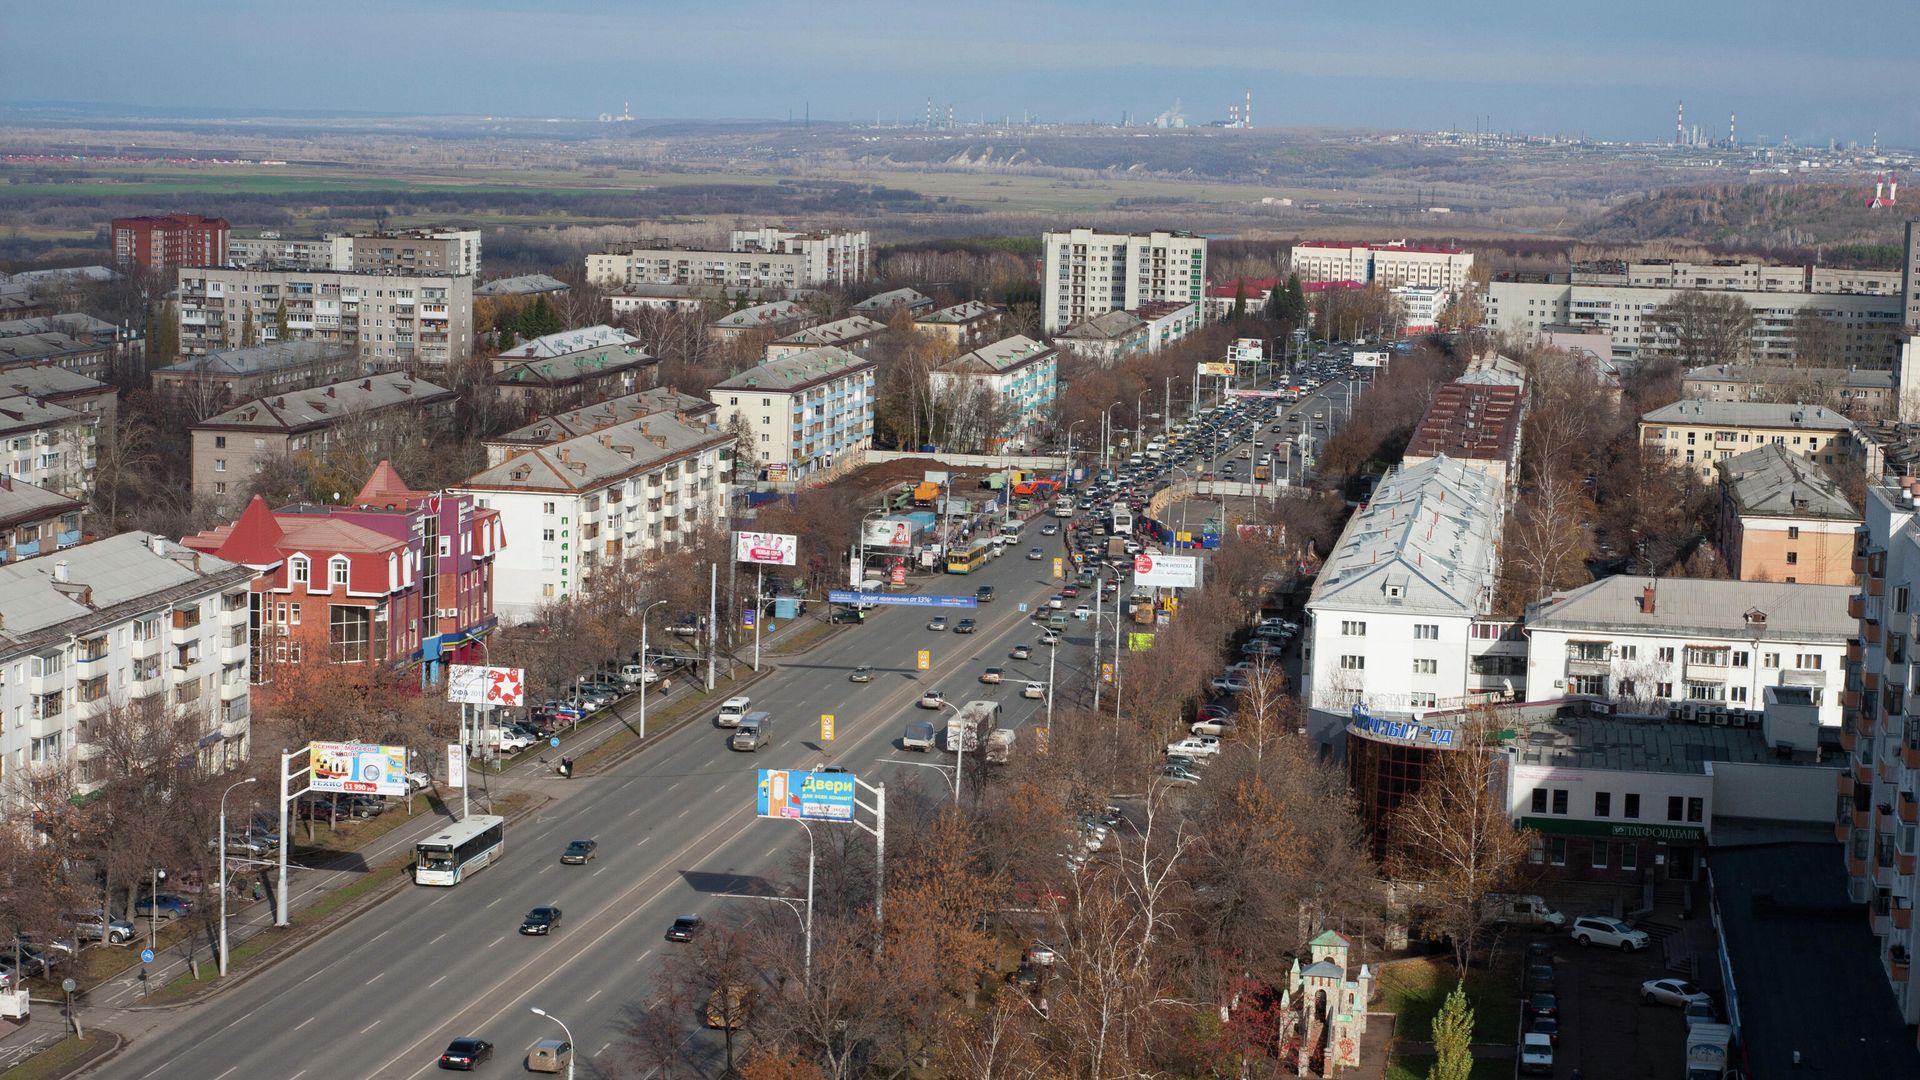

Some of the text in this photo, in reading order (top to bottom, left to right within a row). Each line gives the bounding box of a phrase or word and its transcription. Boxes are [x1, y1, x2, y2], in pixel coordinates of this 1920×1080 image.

[353, 783, 366, 791] 990
[801, 776, 853, 794] Двери
[1626, 826, 1700, 840] ТАТФОНДБАНК
